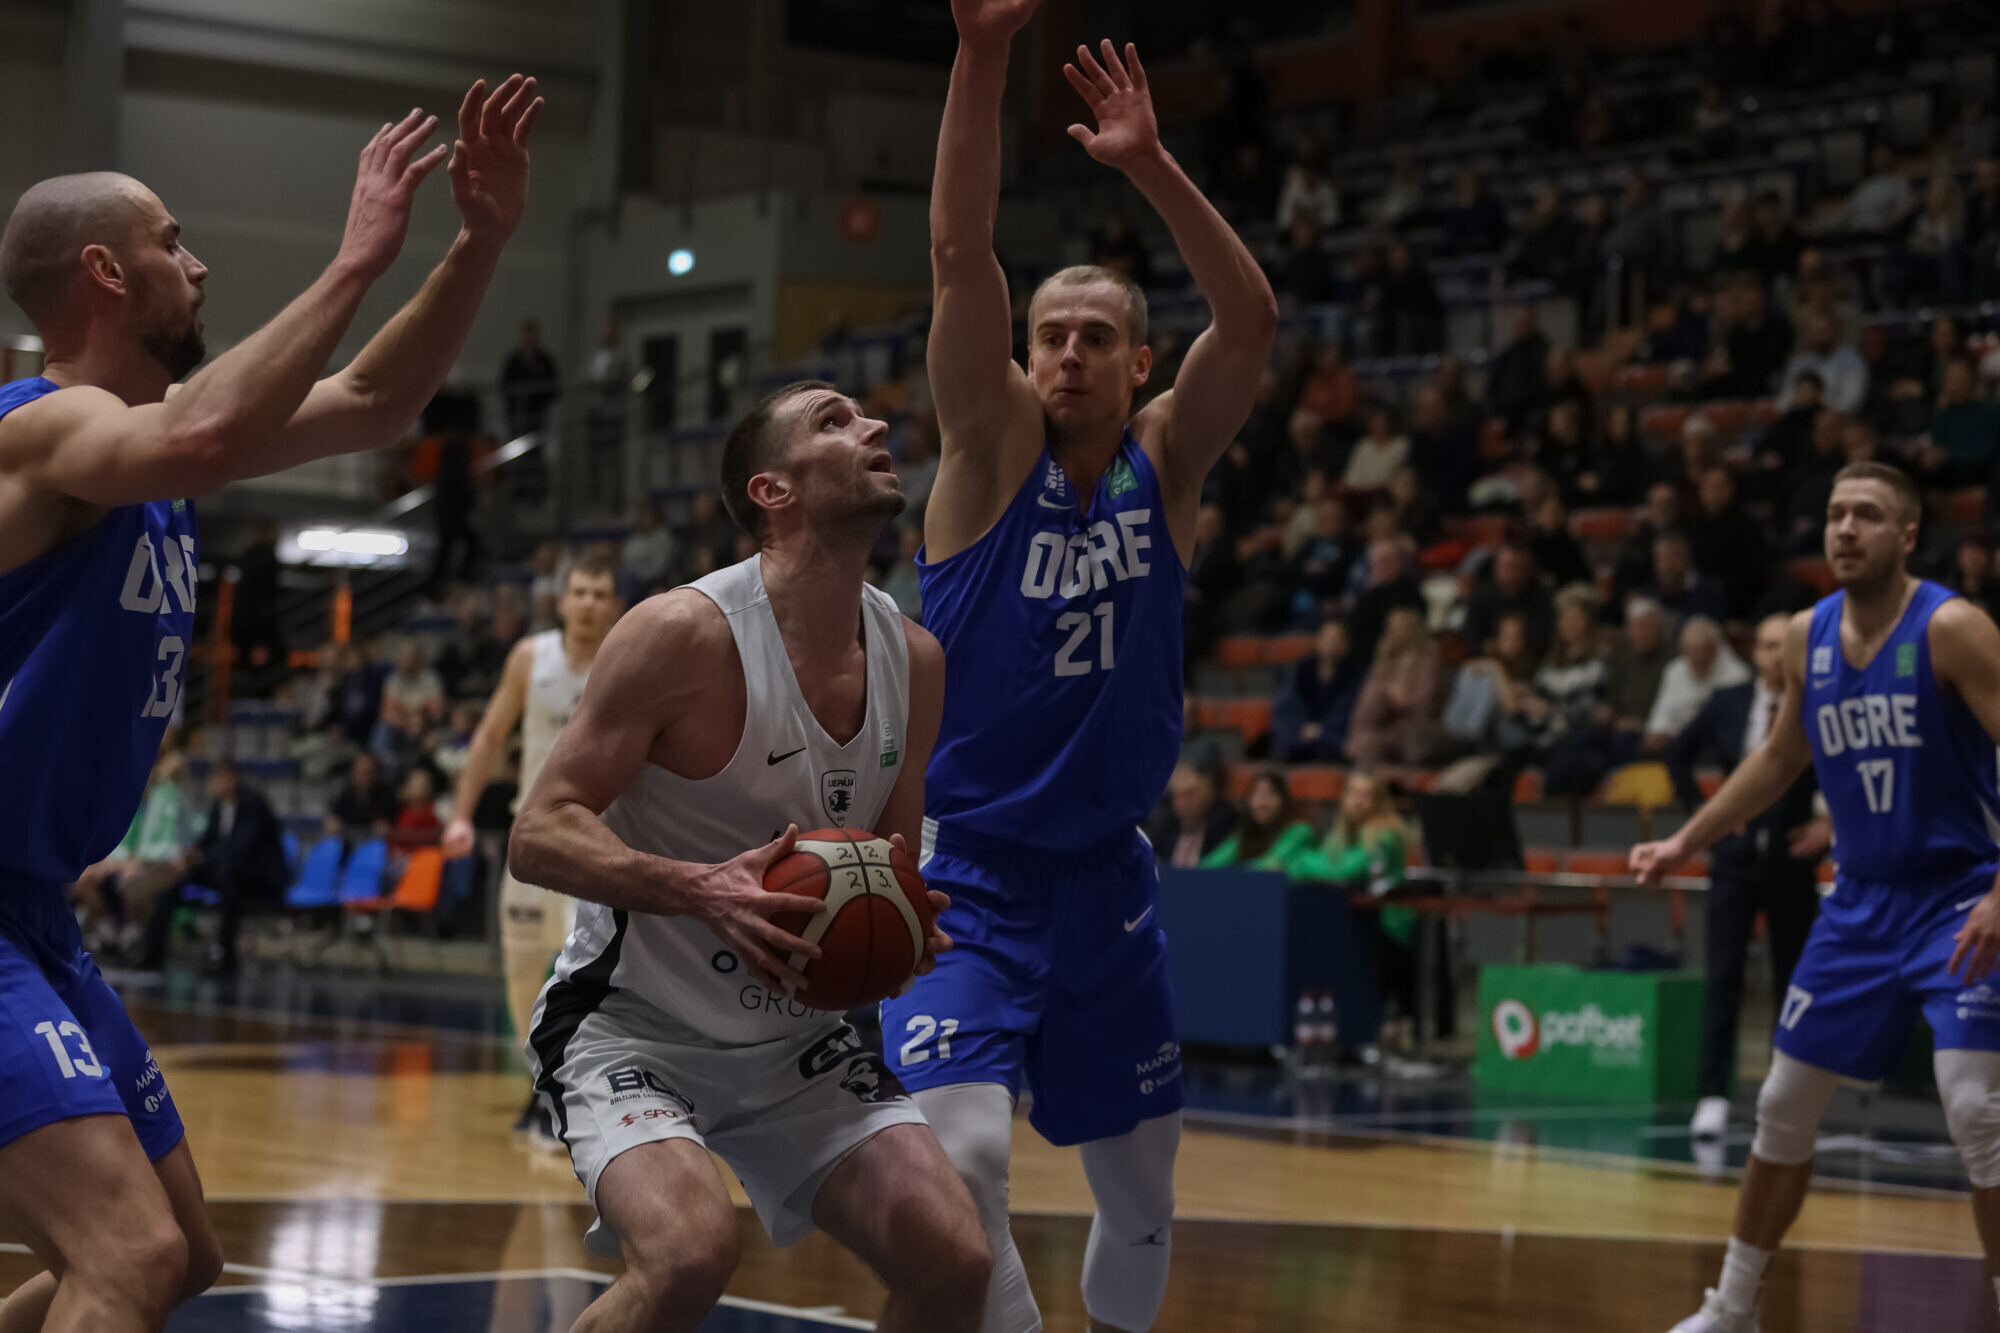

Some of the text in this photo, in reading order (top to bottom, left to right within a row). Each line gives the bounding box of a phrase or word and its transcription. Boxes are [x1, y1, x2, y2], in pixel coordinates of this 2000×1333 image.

[1020, 509, 1152, 600] OGRE
[1054, 601, 1115, 677] 21
[1817, 694, 1924, 758] OGRE
[1856, 757, 1895, 814] 17
[1779, 983, 1814, 1031] 17
[34, 1020, 103, 1079] 13
[900, 1015, 959, 1067] 21
